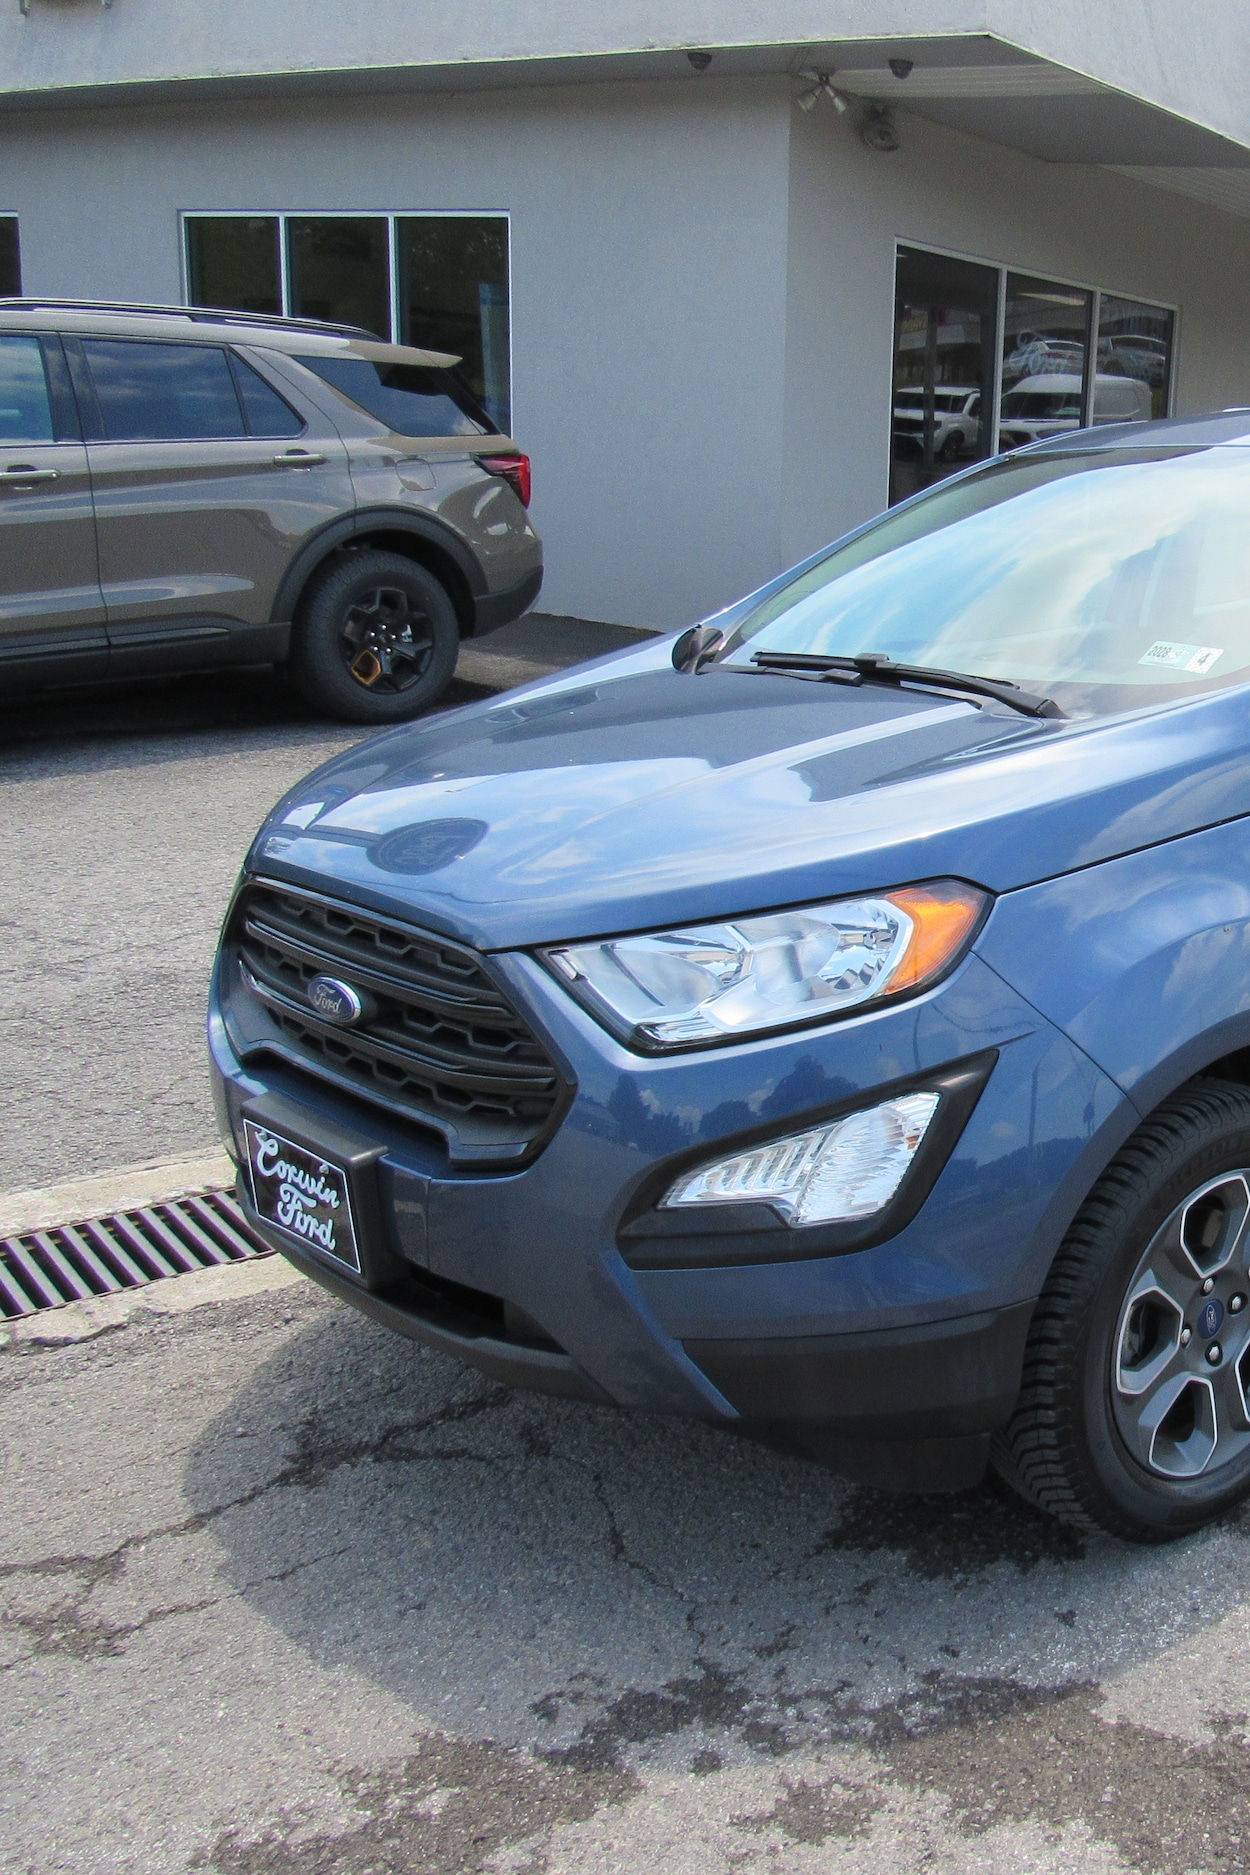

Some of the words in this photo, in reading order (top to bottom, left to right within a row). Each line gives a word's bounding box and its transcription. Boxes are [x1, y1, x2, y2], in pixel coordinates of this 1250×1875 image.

[1197, 653, 1211, 666] 4
[314, 983, 343, 1013] Ford
[254, 1131, 340, 1209] Corwin
[277, 1182, 336, 1250] Ford
